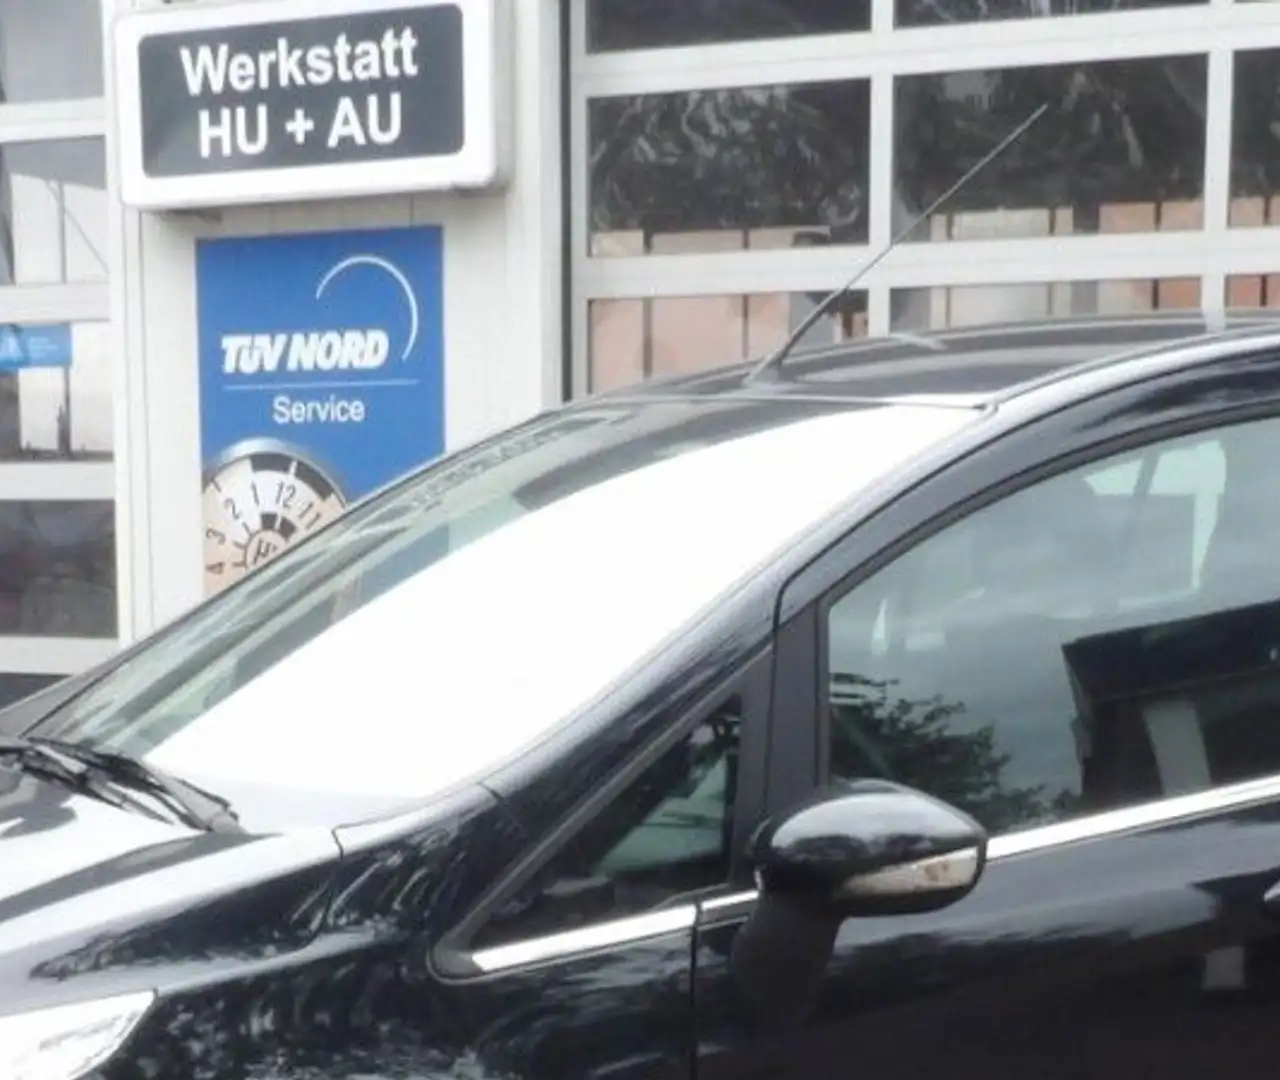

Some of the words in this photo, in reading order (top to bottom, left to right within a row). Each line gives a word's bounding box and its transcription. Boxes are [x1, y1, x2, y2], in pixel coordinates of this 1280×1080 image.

[179, 26, 419, 96] Werkstatt
[198, 104, 269, 159] HU
[284, 107, 315, 145] +
[327, 92, 402, 149] AU
[221, 333, 287, 374] TÜV
[286, 329, 390, 371] NORD
[272, 393, 366, 425] Service
[224, 497, 241, 520] 2
[276, 481, 296, 508] 12
[298, 501, 321, 530] 11
[205, 528, 226, 546] 3
